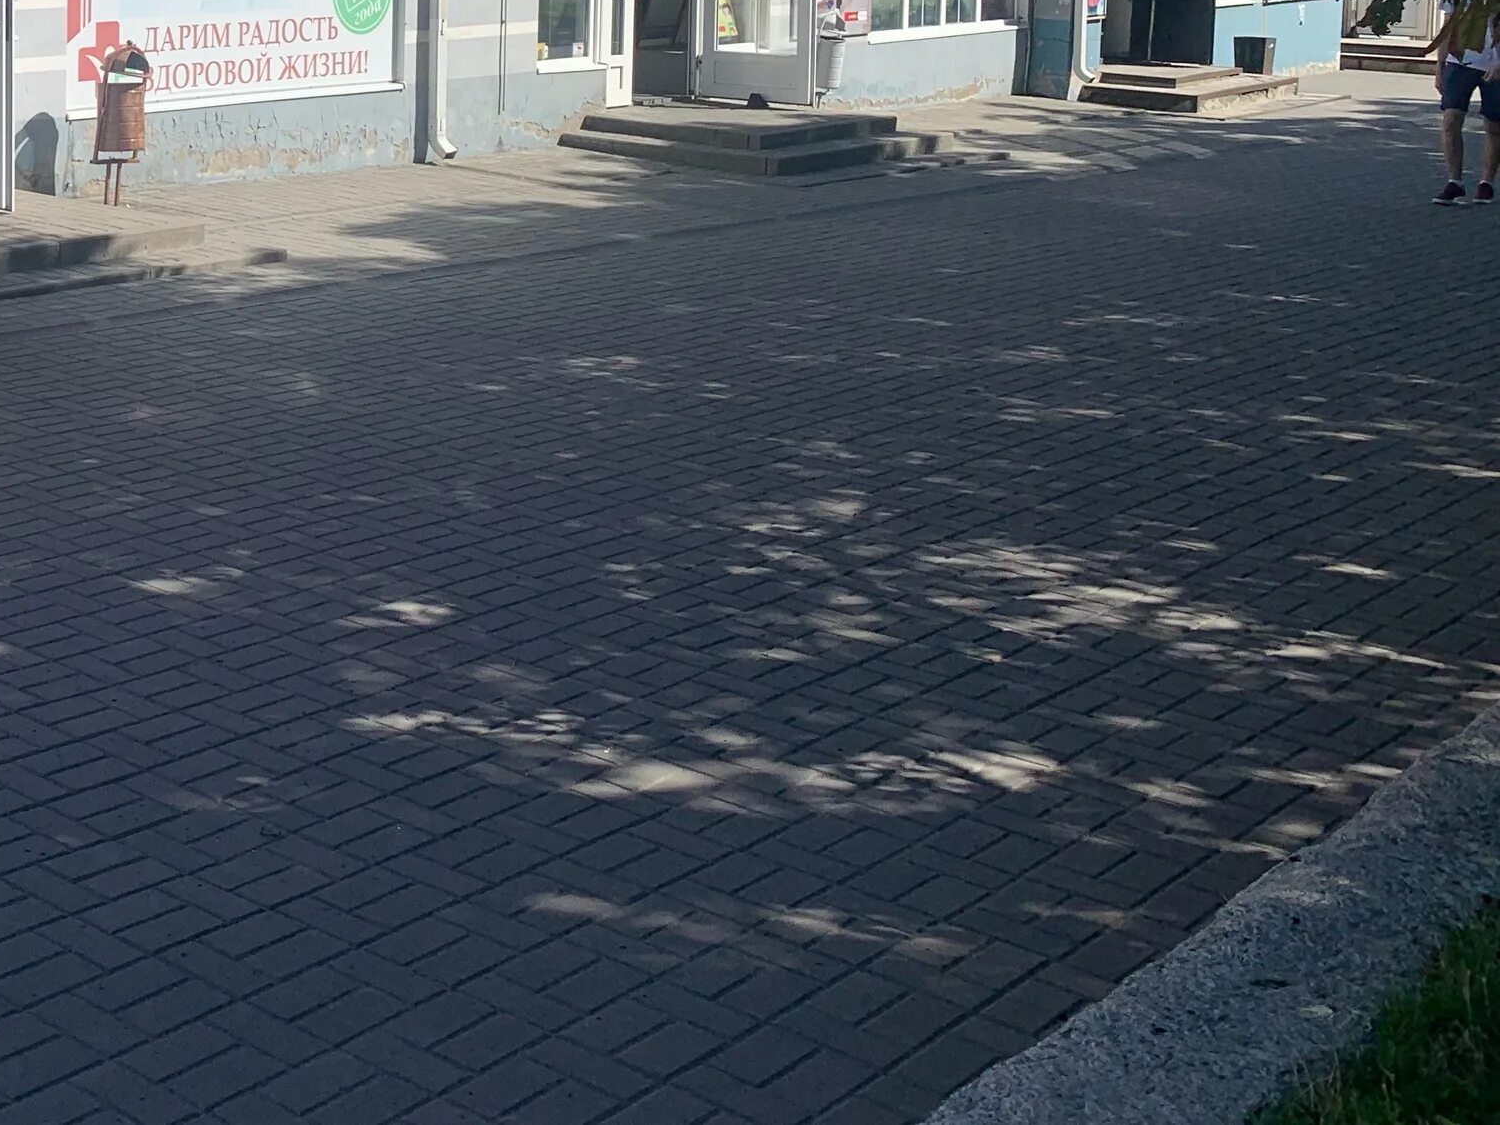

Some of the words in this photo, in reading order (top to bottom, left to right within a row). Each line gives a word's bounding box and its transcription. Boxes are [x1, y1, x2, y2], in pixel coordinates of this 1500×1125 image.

[354, 0, 382, 25] года
[143, 22, 231, 56] ДАРИМ
[237, 16, 339, 48] РАДОСТЬ
[278, 49, 369, 81] ЖИЗНИ!
